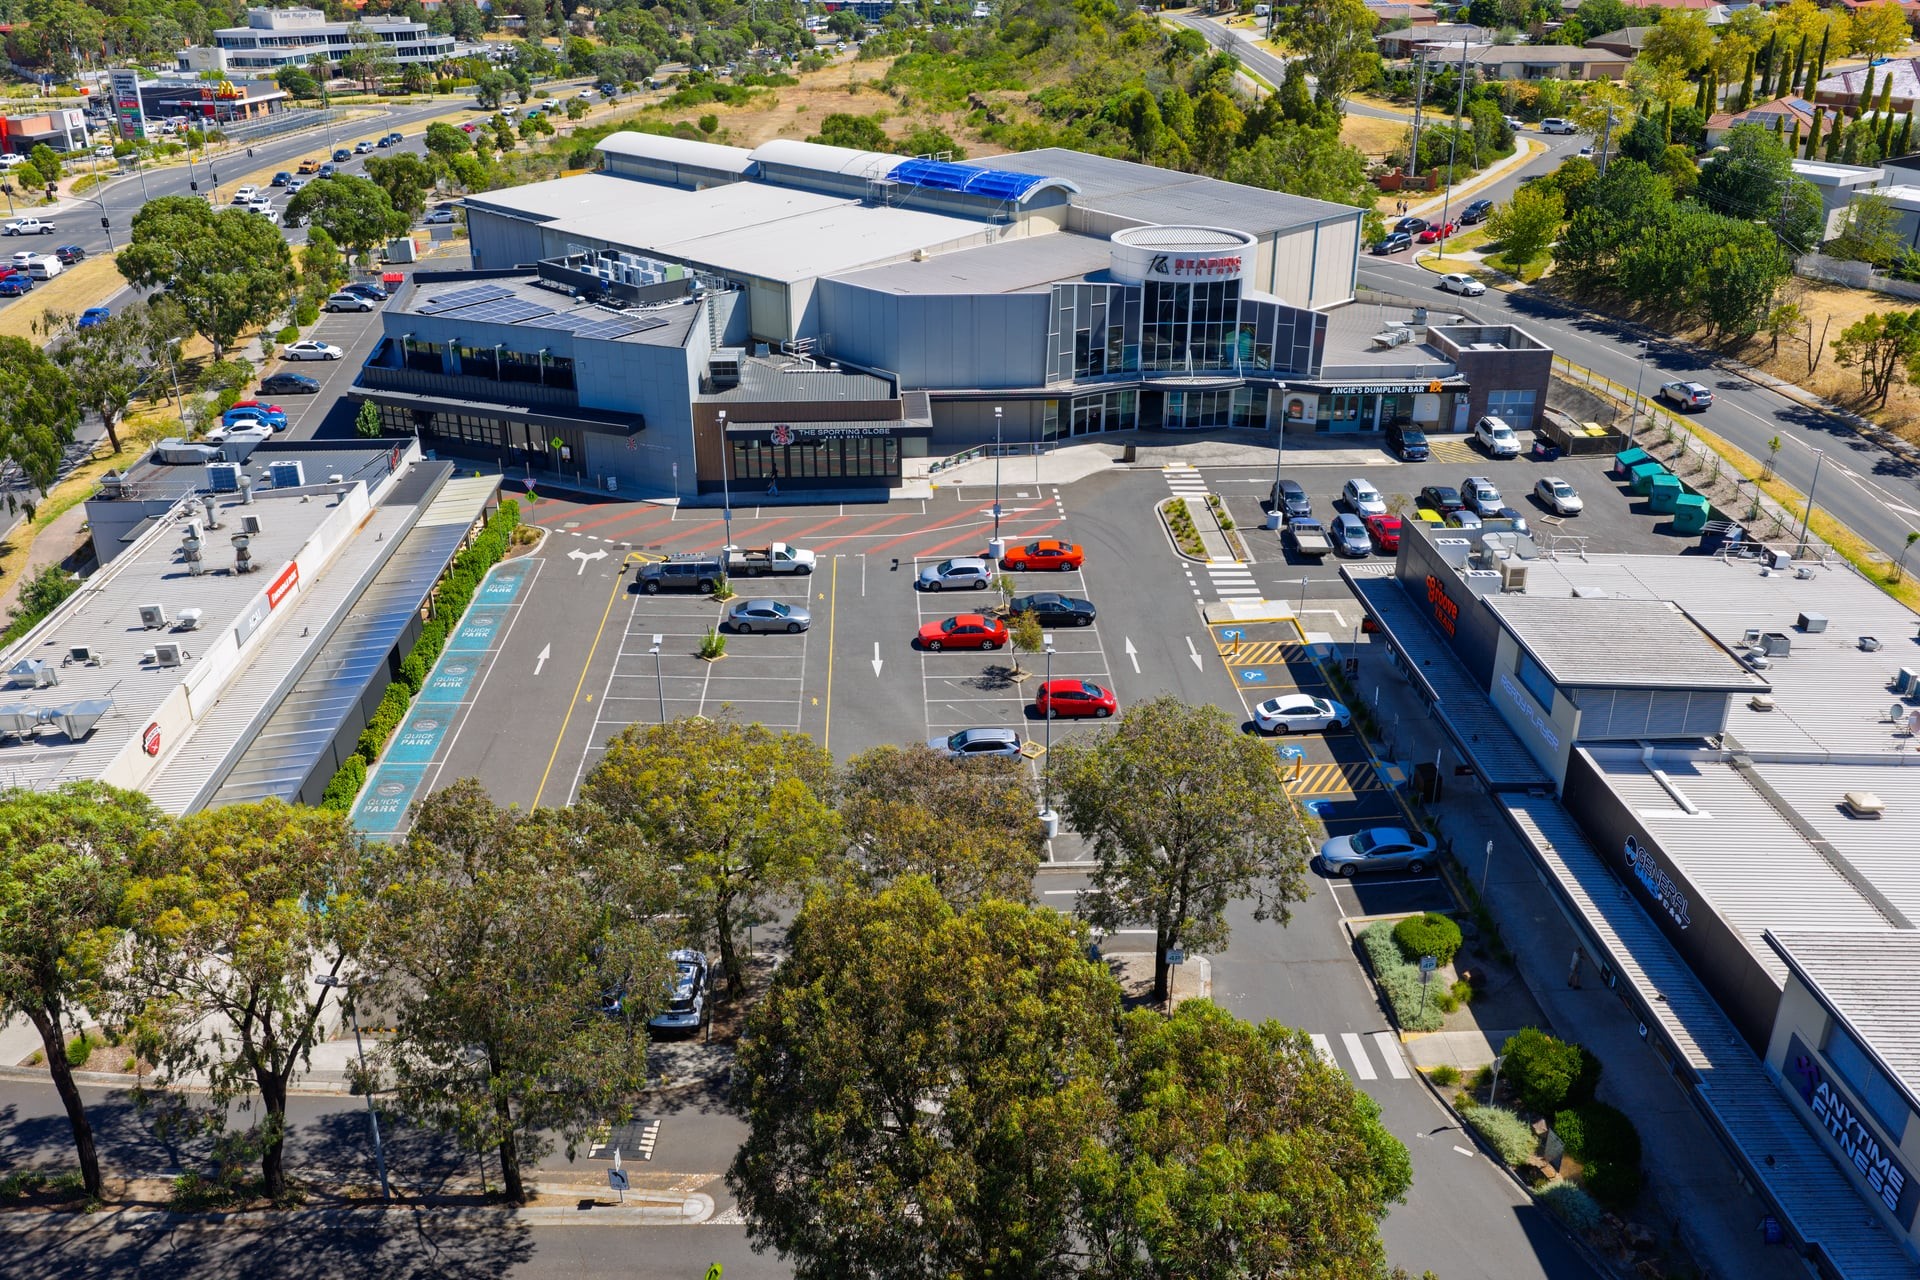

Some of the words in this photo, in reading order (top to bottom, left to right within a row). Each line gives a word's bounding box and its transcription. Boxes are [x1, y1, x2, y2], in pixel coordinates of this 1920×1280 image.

[1175, 256, 1242, 270] READING
[1175, 266, 1241, 276] CINEMAS
[1331, 385, 1363, 395] ANGIE'S
[1364, 385, 1406, 394] DUMPLING
[1408, 385, 1425, 393] BAR
[818, 428, 860, 436] SPORTING
[363, 805, 397, 813] PARK
[1634, 860, 1660, 900] GAMES
[1637, 846, 1691, 925] GENERAL
[1815, 1080, 1905, 1194] ANYTIME
[1811, 1095, 1899, 1212] FITNESS
